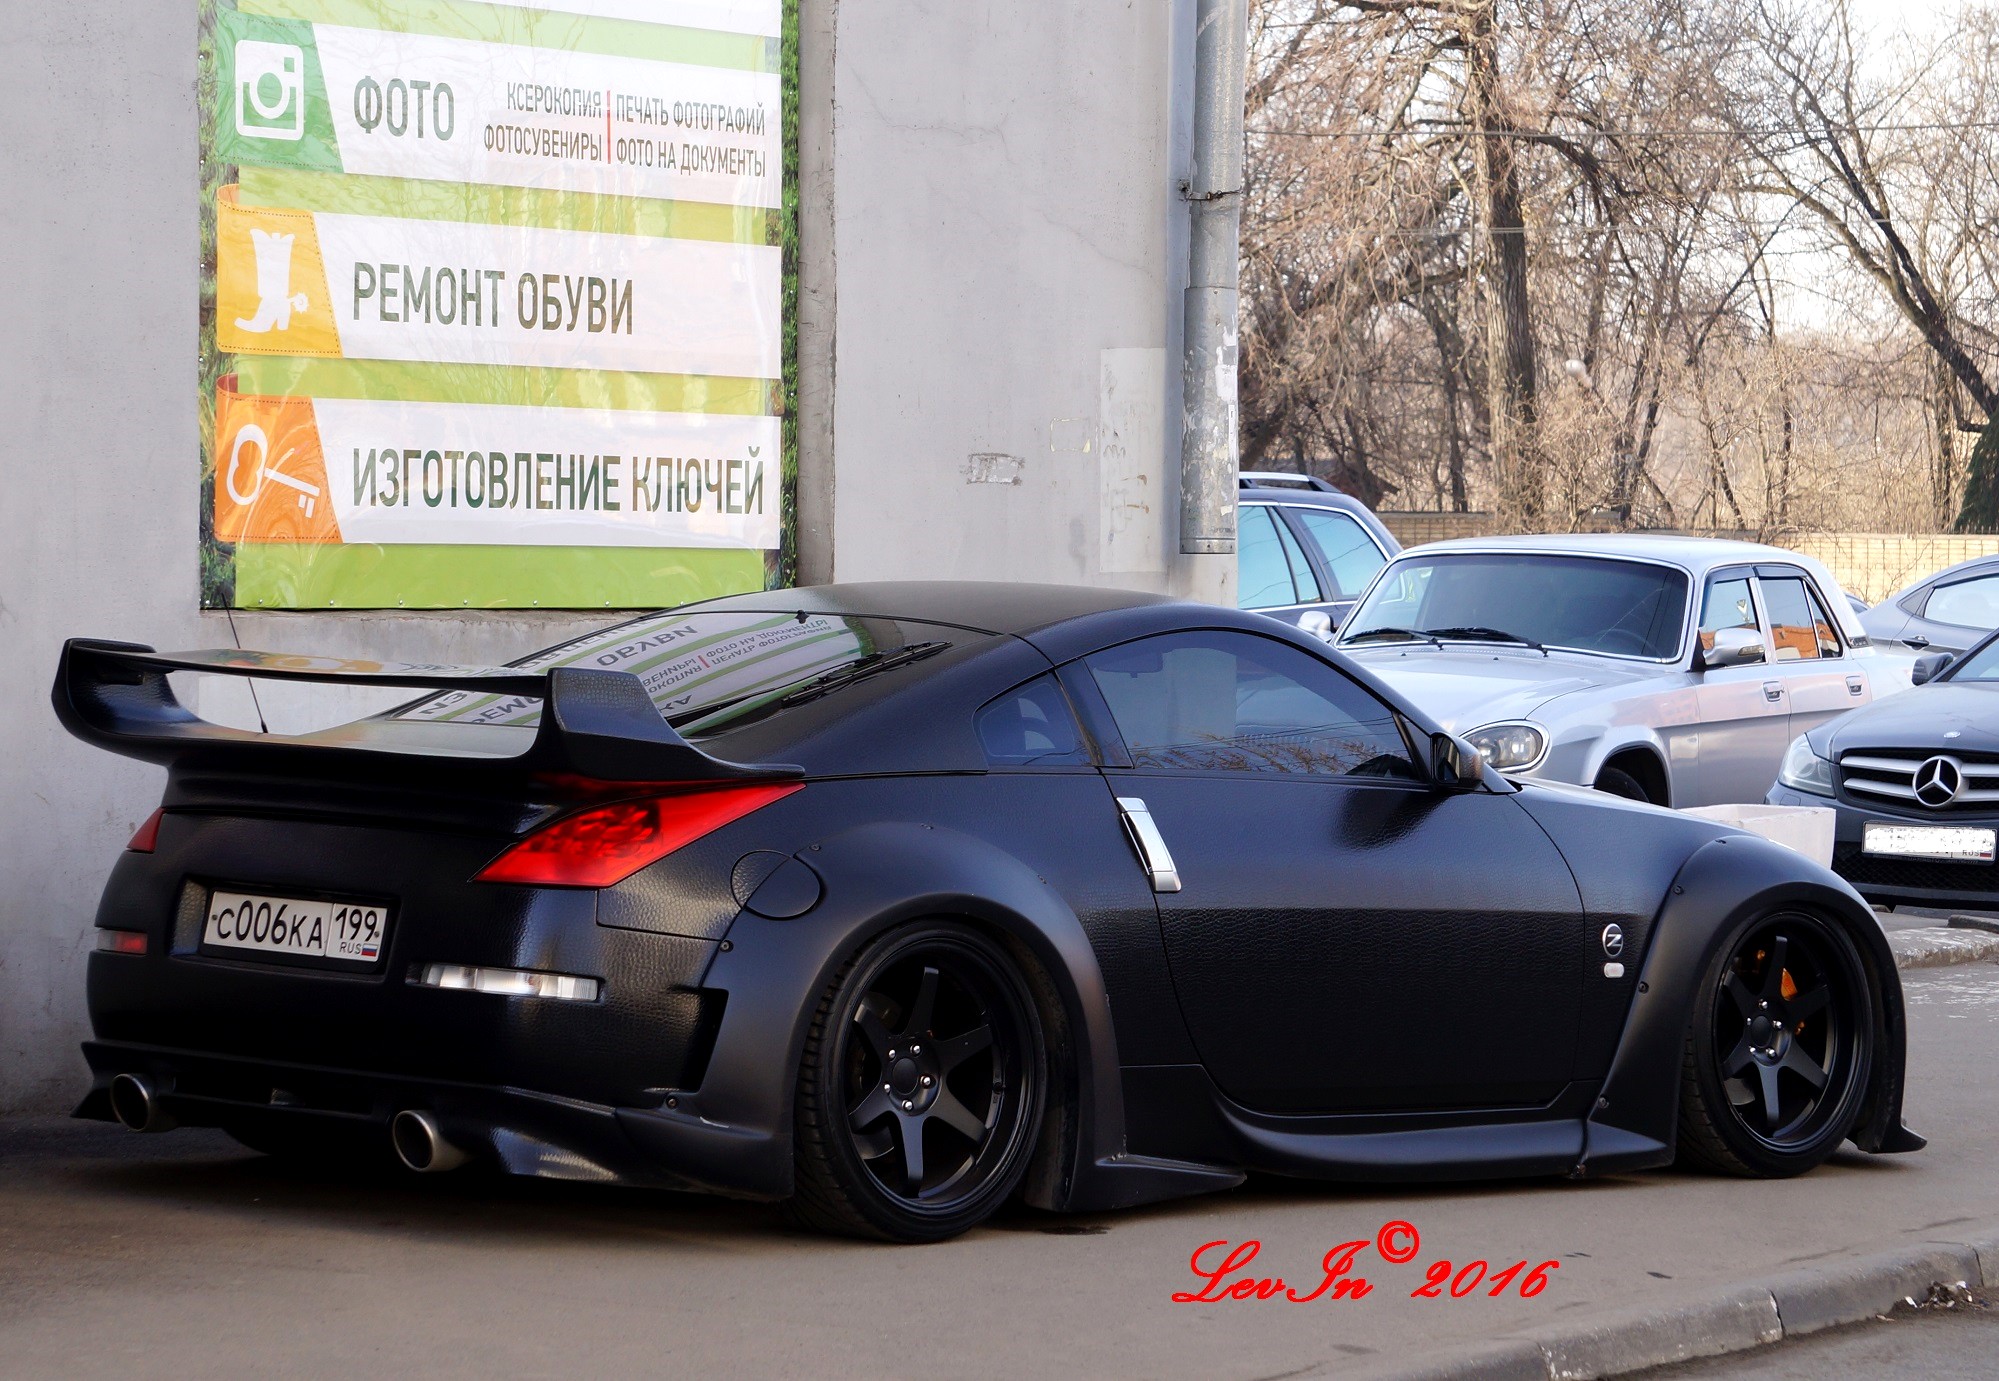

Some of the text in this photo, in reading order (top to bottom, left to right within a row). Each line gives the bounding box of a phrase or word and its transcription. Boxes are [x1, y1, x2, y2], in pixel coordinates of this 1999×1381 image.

[353, 75, 455, 141] ФОТО
[507, 82, 601, 118] КСЕРОКОПИЯ
[616, 94, 765, 136] ПЕЧАТЬ ФОТОГРАФИЙ
[484, 124, 601, 162] ФОТОСУВЕНИРЫ
[616, 137, 765, 177] ФОТО НА ДОКУМЕНТЫ
[353, 261, 632, 335] РЕМОНТ ОБУВИ
[352, 445, 764, 515] ИЗГОТОВЛЕНИЕ КЛЮЧЕЙ
[335, 908, 378, 942] 199
[339, 942, 361, 955] RUS
